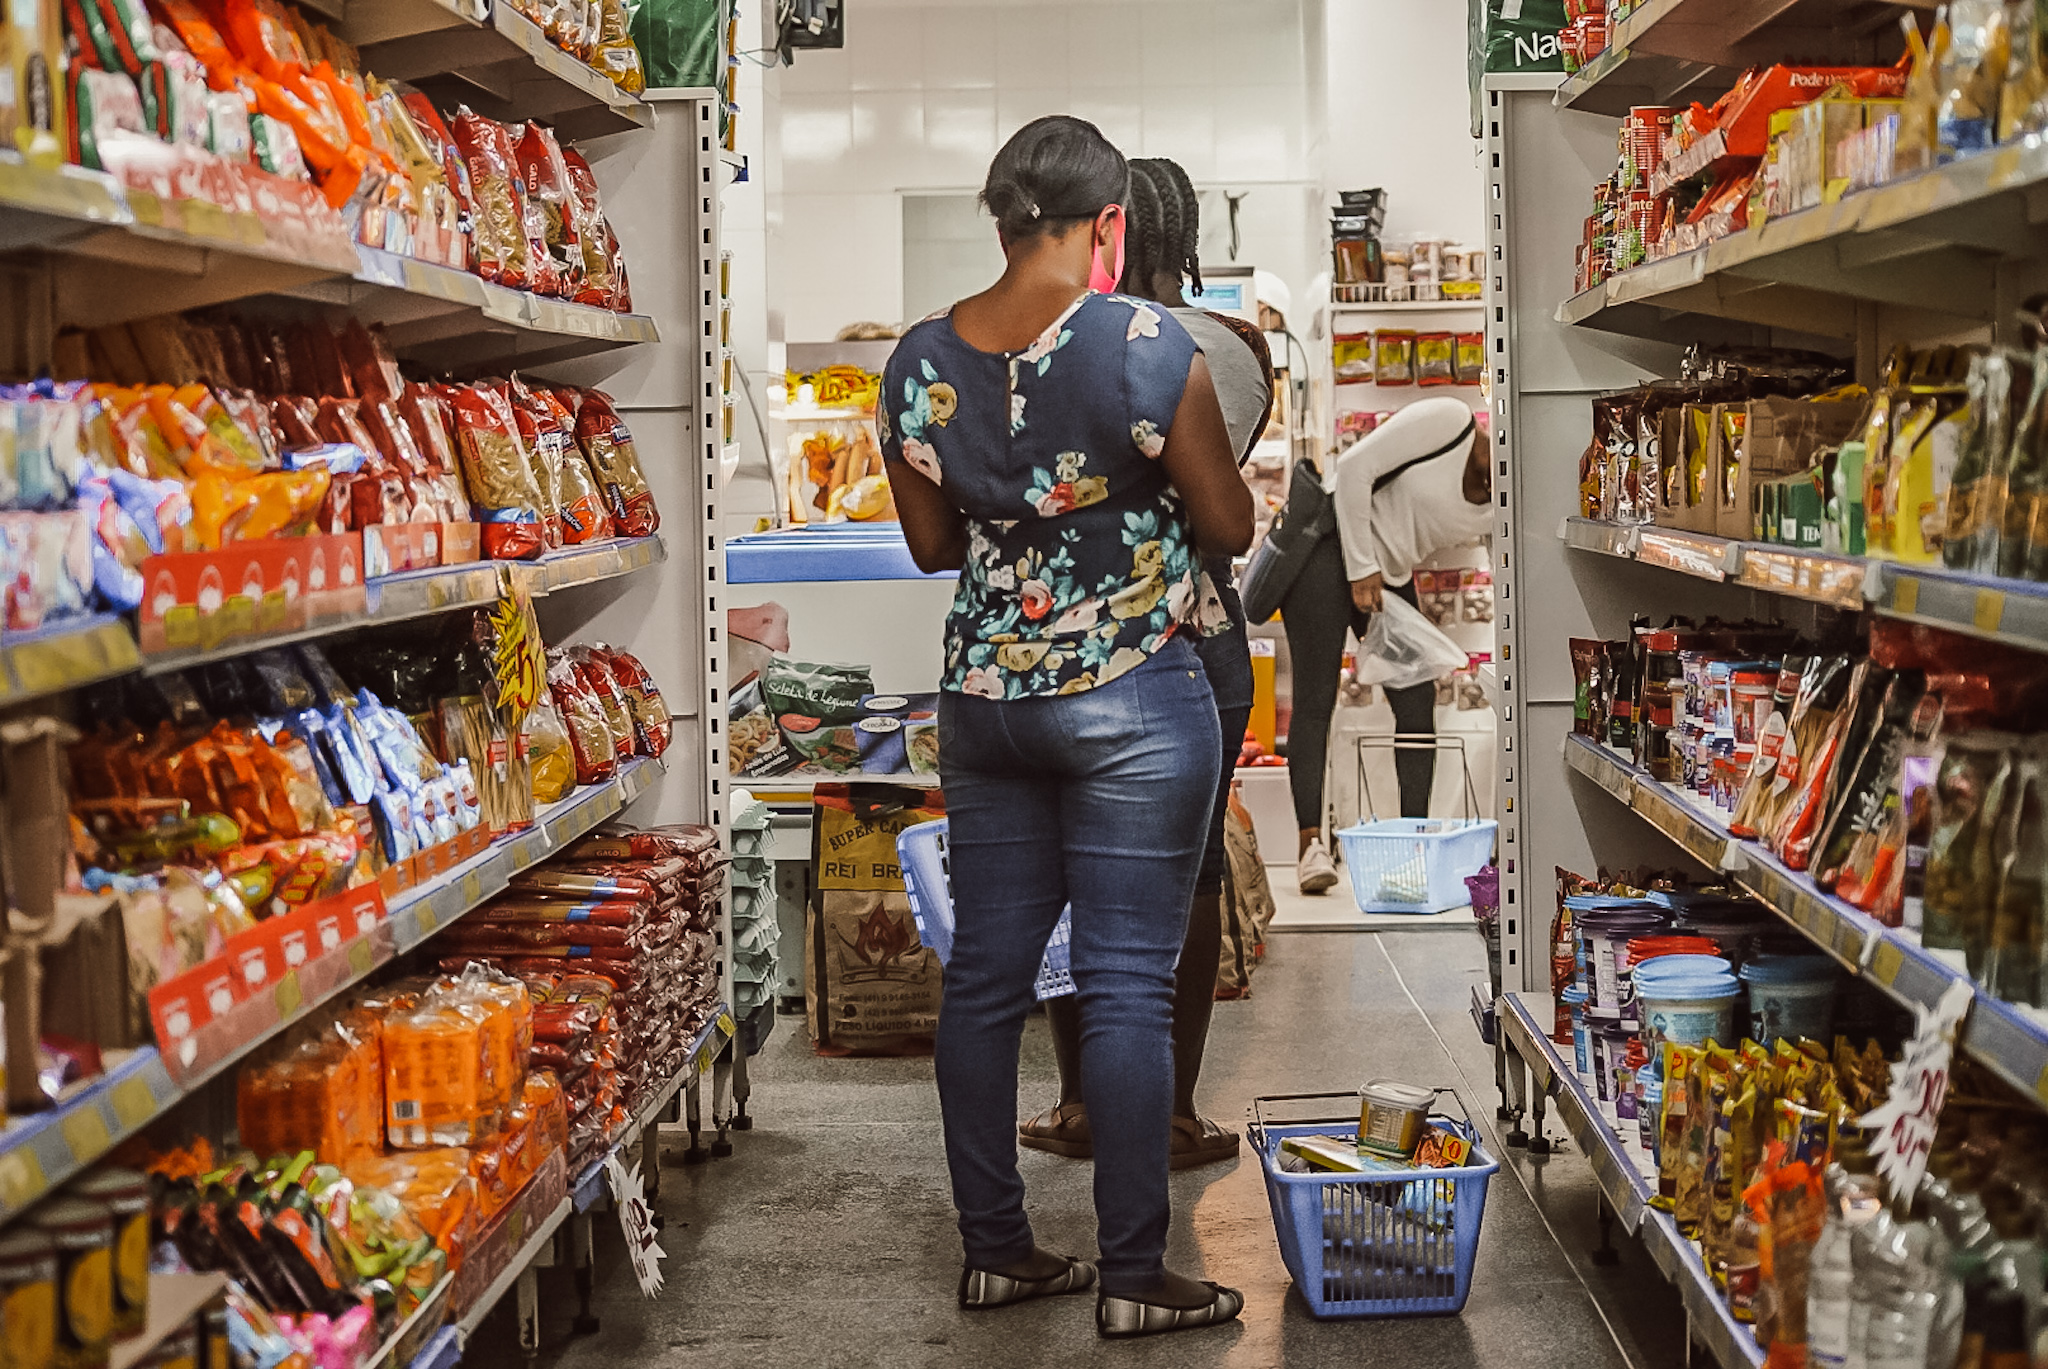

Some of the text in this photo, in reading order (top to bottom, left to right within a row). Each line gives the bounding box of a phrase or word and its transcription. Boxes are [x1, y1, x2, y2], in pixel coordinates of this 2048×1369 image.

[468, 155, 482, 186] GALO
[527, 161, 540, 191] GALO
[805, 687, 819, 702] de
[763, 751, 773, 760] de
[773, 745, 788, 757] Lula
[750, 753, 790, 778] Empanados
[828, 821, 875, 852] SUPER
[825, 860, 904, 879] REI BR
[834, 1020, 862, 1032] PESO
[923, 1017, 937, 1030] kg
